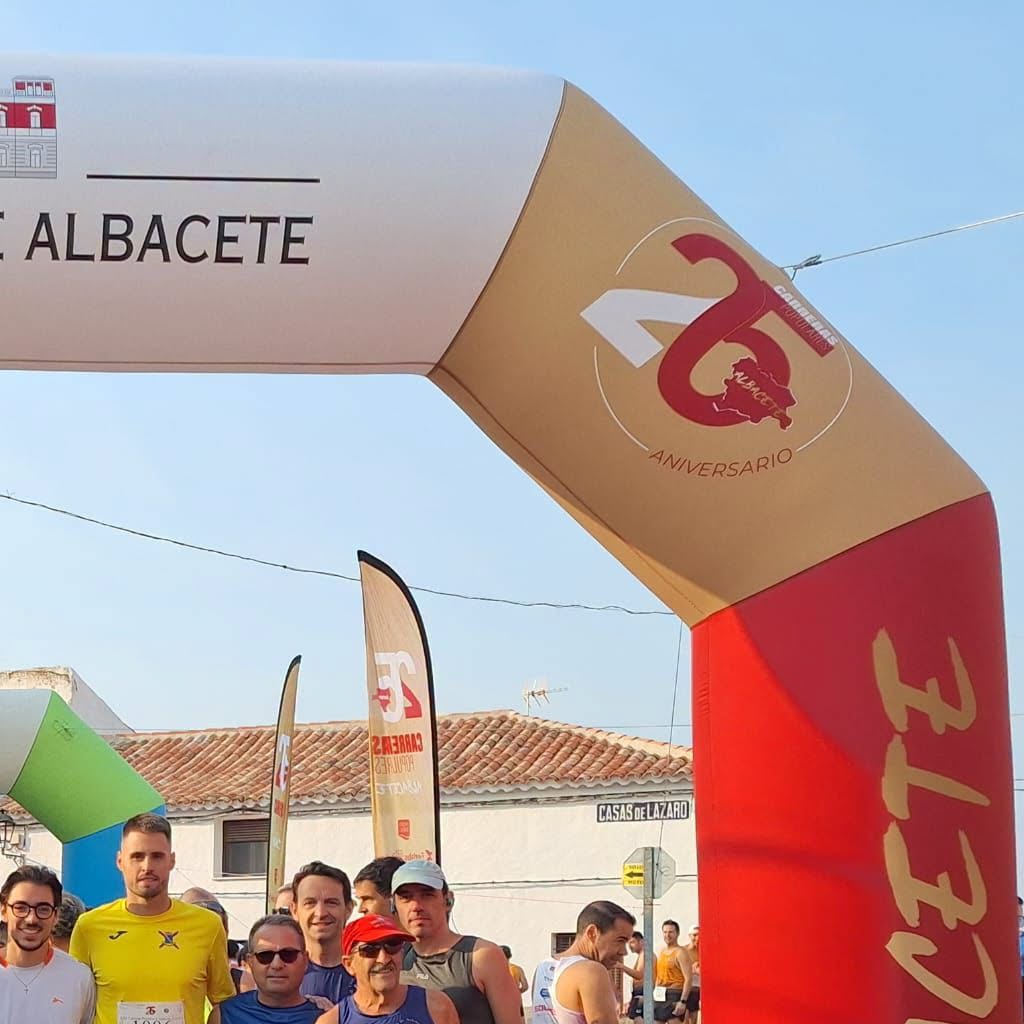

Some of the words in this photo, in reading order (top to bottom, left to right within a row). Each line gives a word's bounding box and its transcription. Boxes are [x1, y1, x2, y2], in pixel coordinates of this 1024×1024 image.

[25, 212, 314, 265] ALBACETE
[733, 370, 788, 417] ALBACETE
[649, 448, 793, 478] ANIVERSARIO
[598, 804, 633, 822] CASAS
[634, 806, 646, 820] DE
[647, 802, 687, 819] LAZARO
